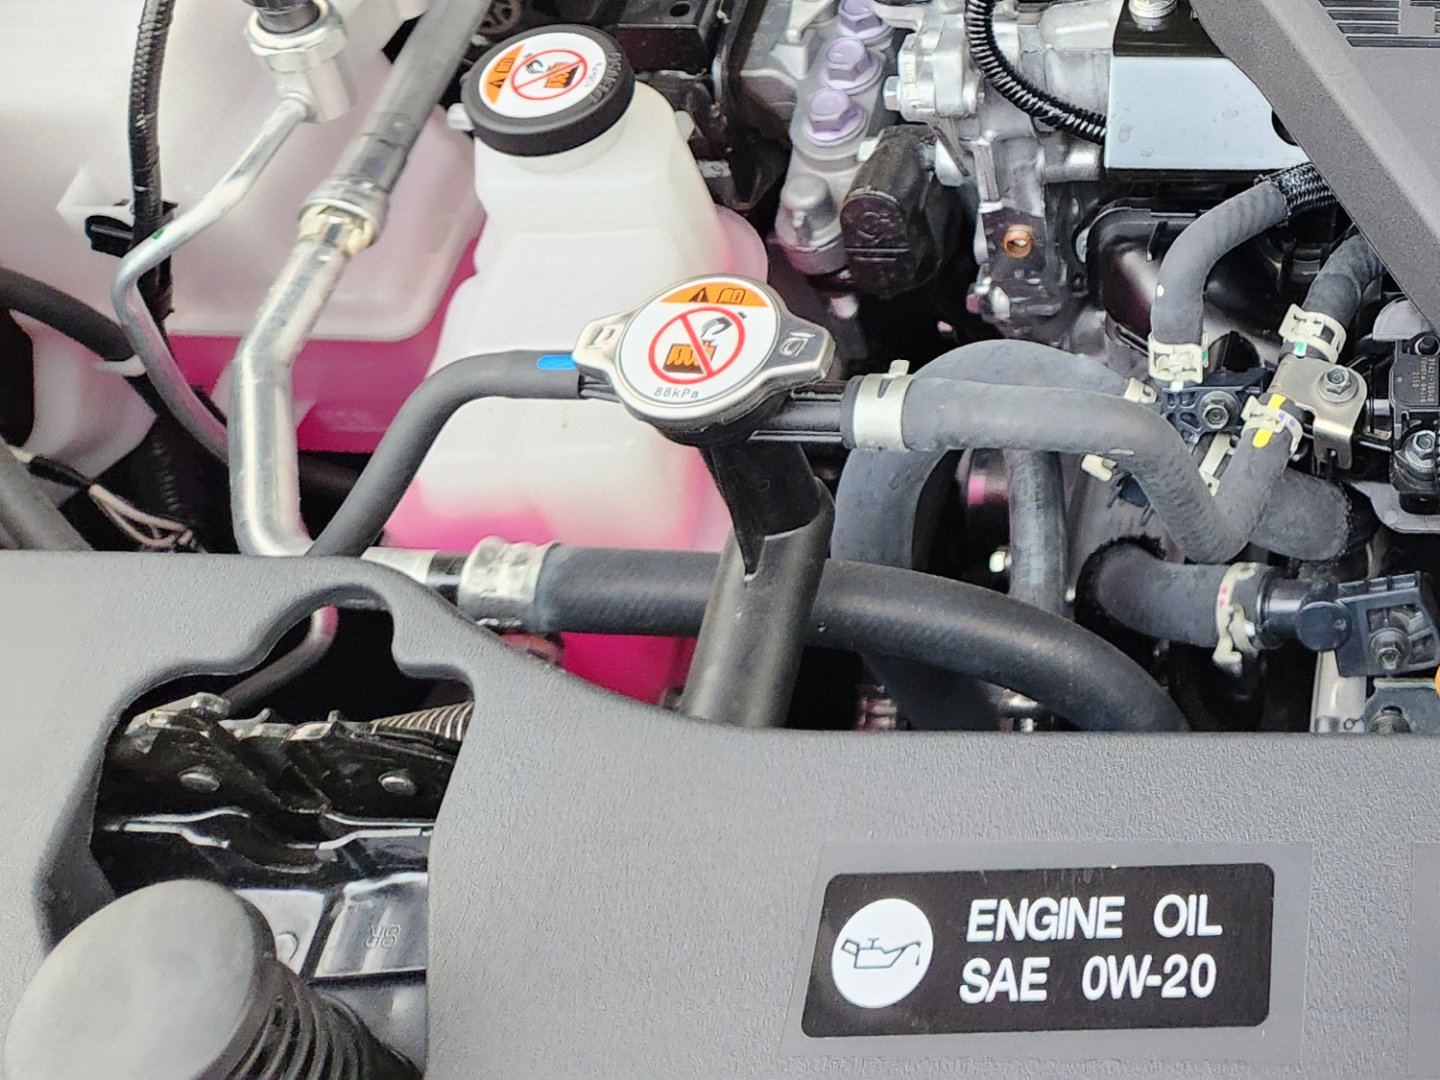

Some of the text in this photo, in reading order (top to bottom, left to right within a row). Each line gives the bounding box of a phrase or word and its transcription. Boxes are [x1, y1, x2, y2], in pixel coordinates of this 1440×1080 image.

[654, 386, 699, 399] 88kPa
[966, 893, 1222, 942] ENGINE OIL
[959, 953, 1217, 1003] SAE 0W-20
